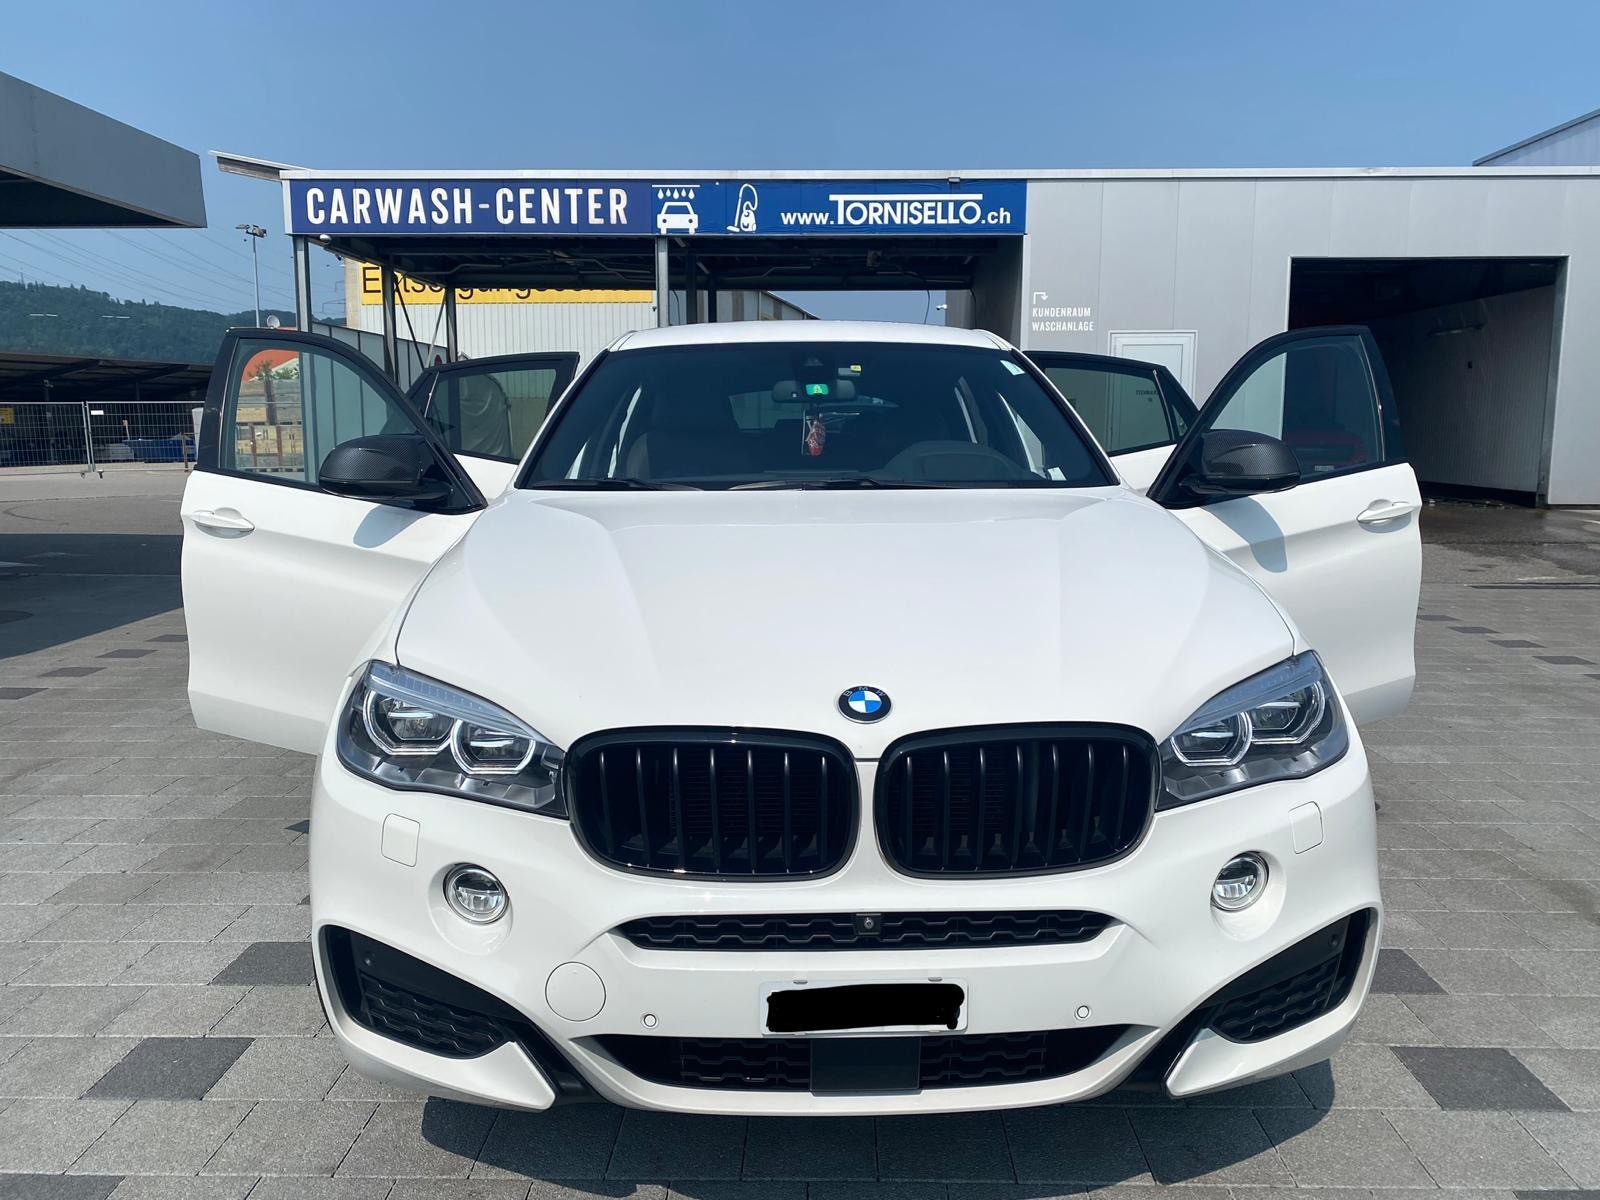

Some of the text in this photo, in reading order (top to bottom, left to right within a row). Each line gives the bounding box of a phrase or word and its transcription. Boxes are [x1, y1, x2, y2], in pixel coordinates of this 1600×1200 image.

[306, 188, 628, 225] CARWASH-CENTER
[780, 194, 1011, 225] www.TORNISELLO.ch
[1032, 307, 1091, 317] KUNDENRAUM
[1032, 321, 1094, 331] WASCHANLAGE
